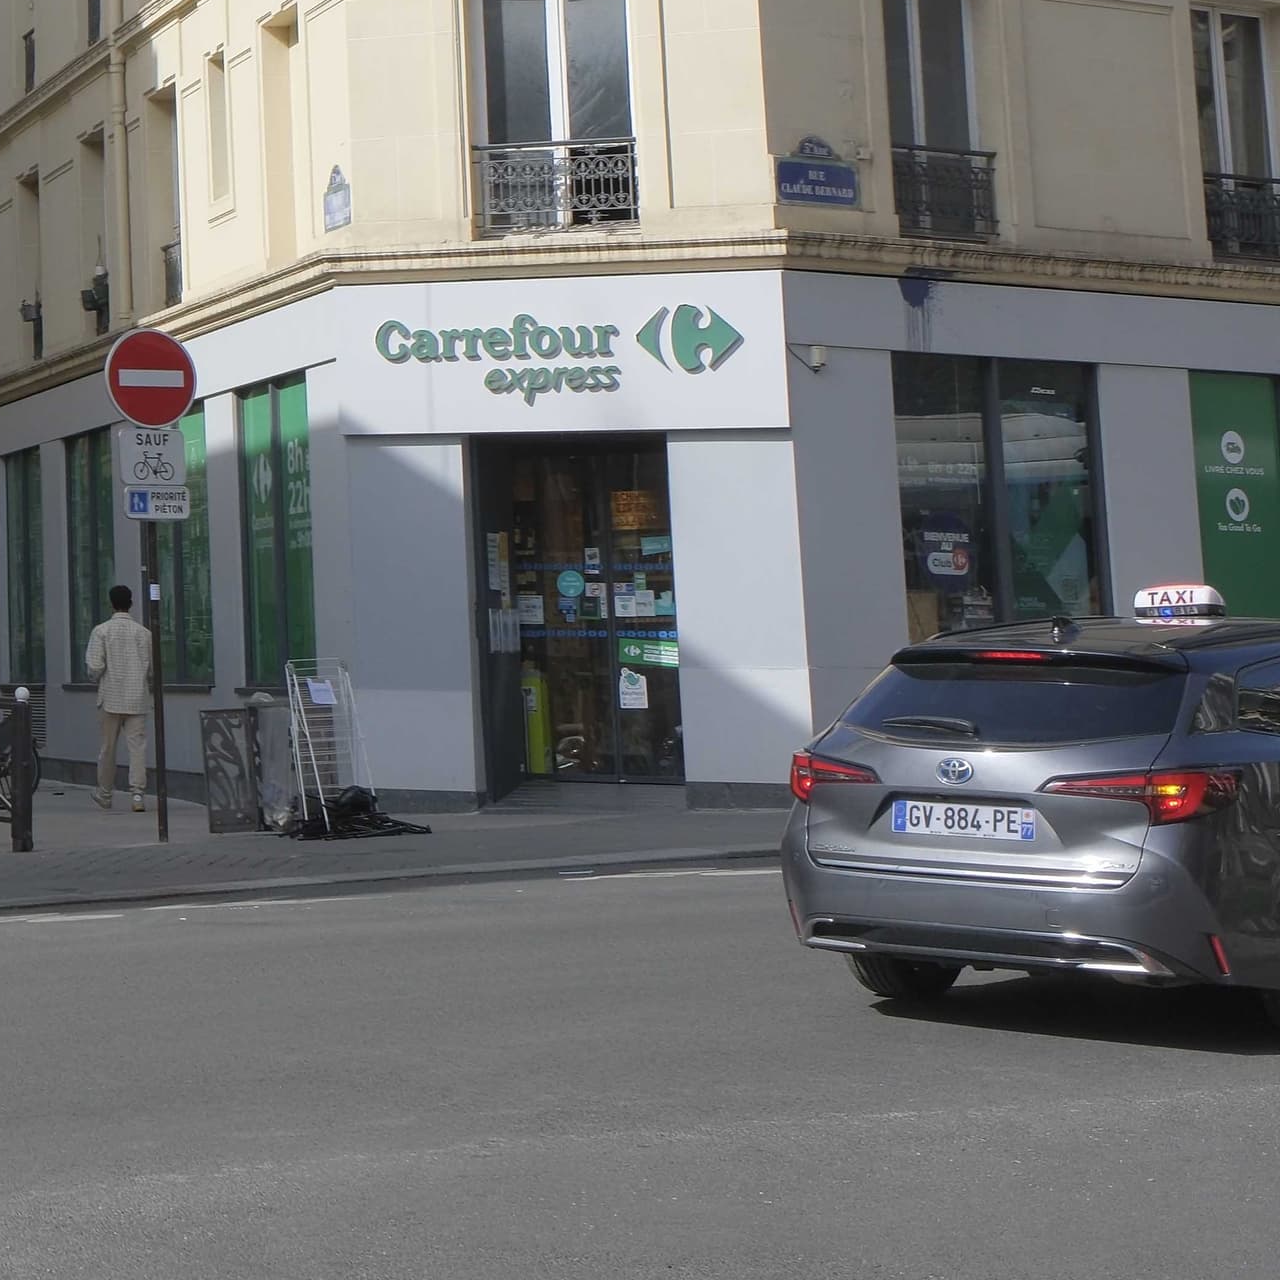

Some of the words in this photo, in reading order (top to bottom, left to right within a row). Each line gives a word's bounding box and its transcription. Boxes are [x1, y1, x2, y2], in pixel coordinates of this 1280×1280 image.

[808, 170, 825, 181] RUE
[781, 183, 814, 194] CLAUDE
[815, 185, 854, 198] BERNARD
[375, 313, 620, 365] Carrefour
[484, 366, 622, 408] express
[136, 433, 169, 447] SAUF
[924, 532, 969, 543] BIENVENUE
[1148, 590, 1194, 606] TAXI
[908, 804, 1019, 834] GV-884-PE
[1022, 824, 1033, 837] 77
